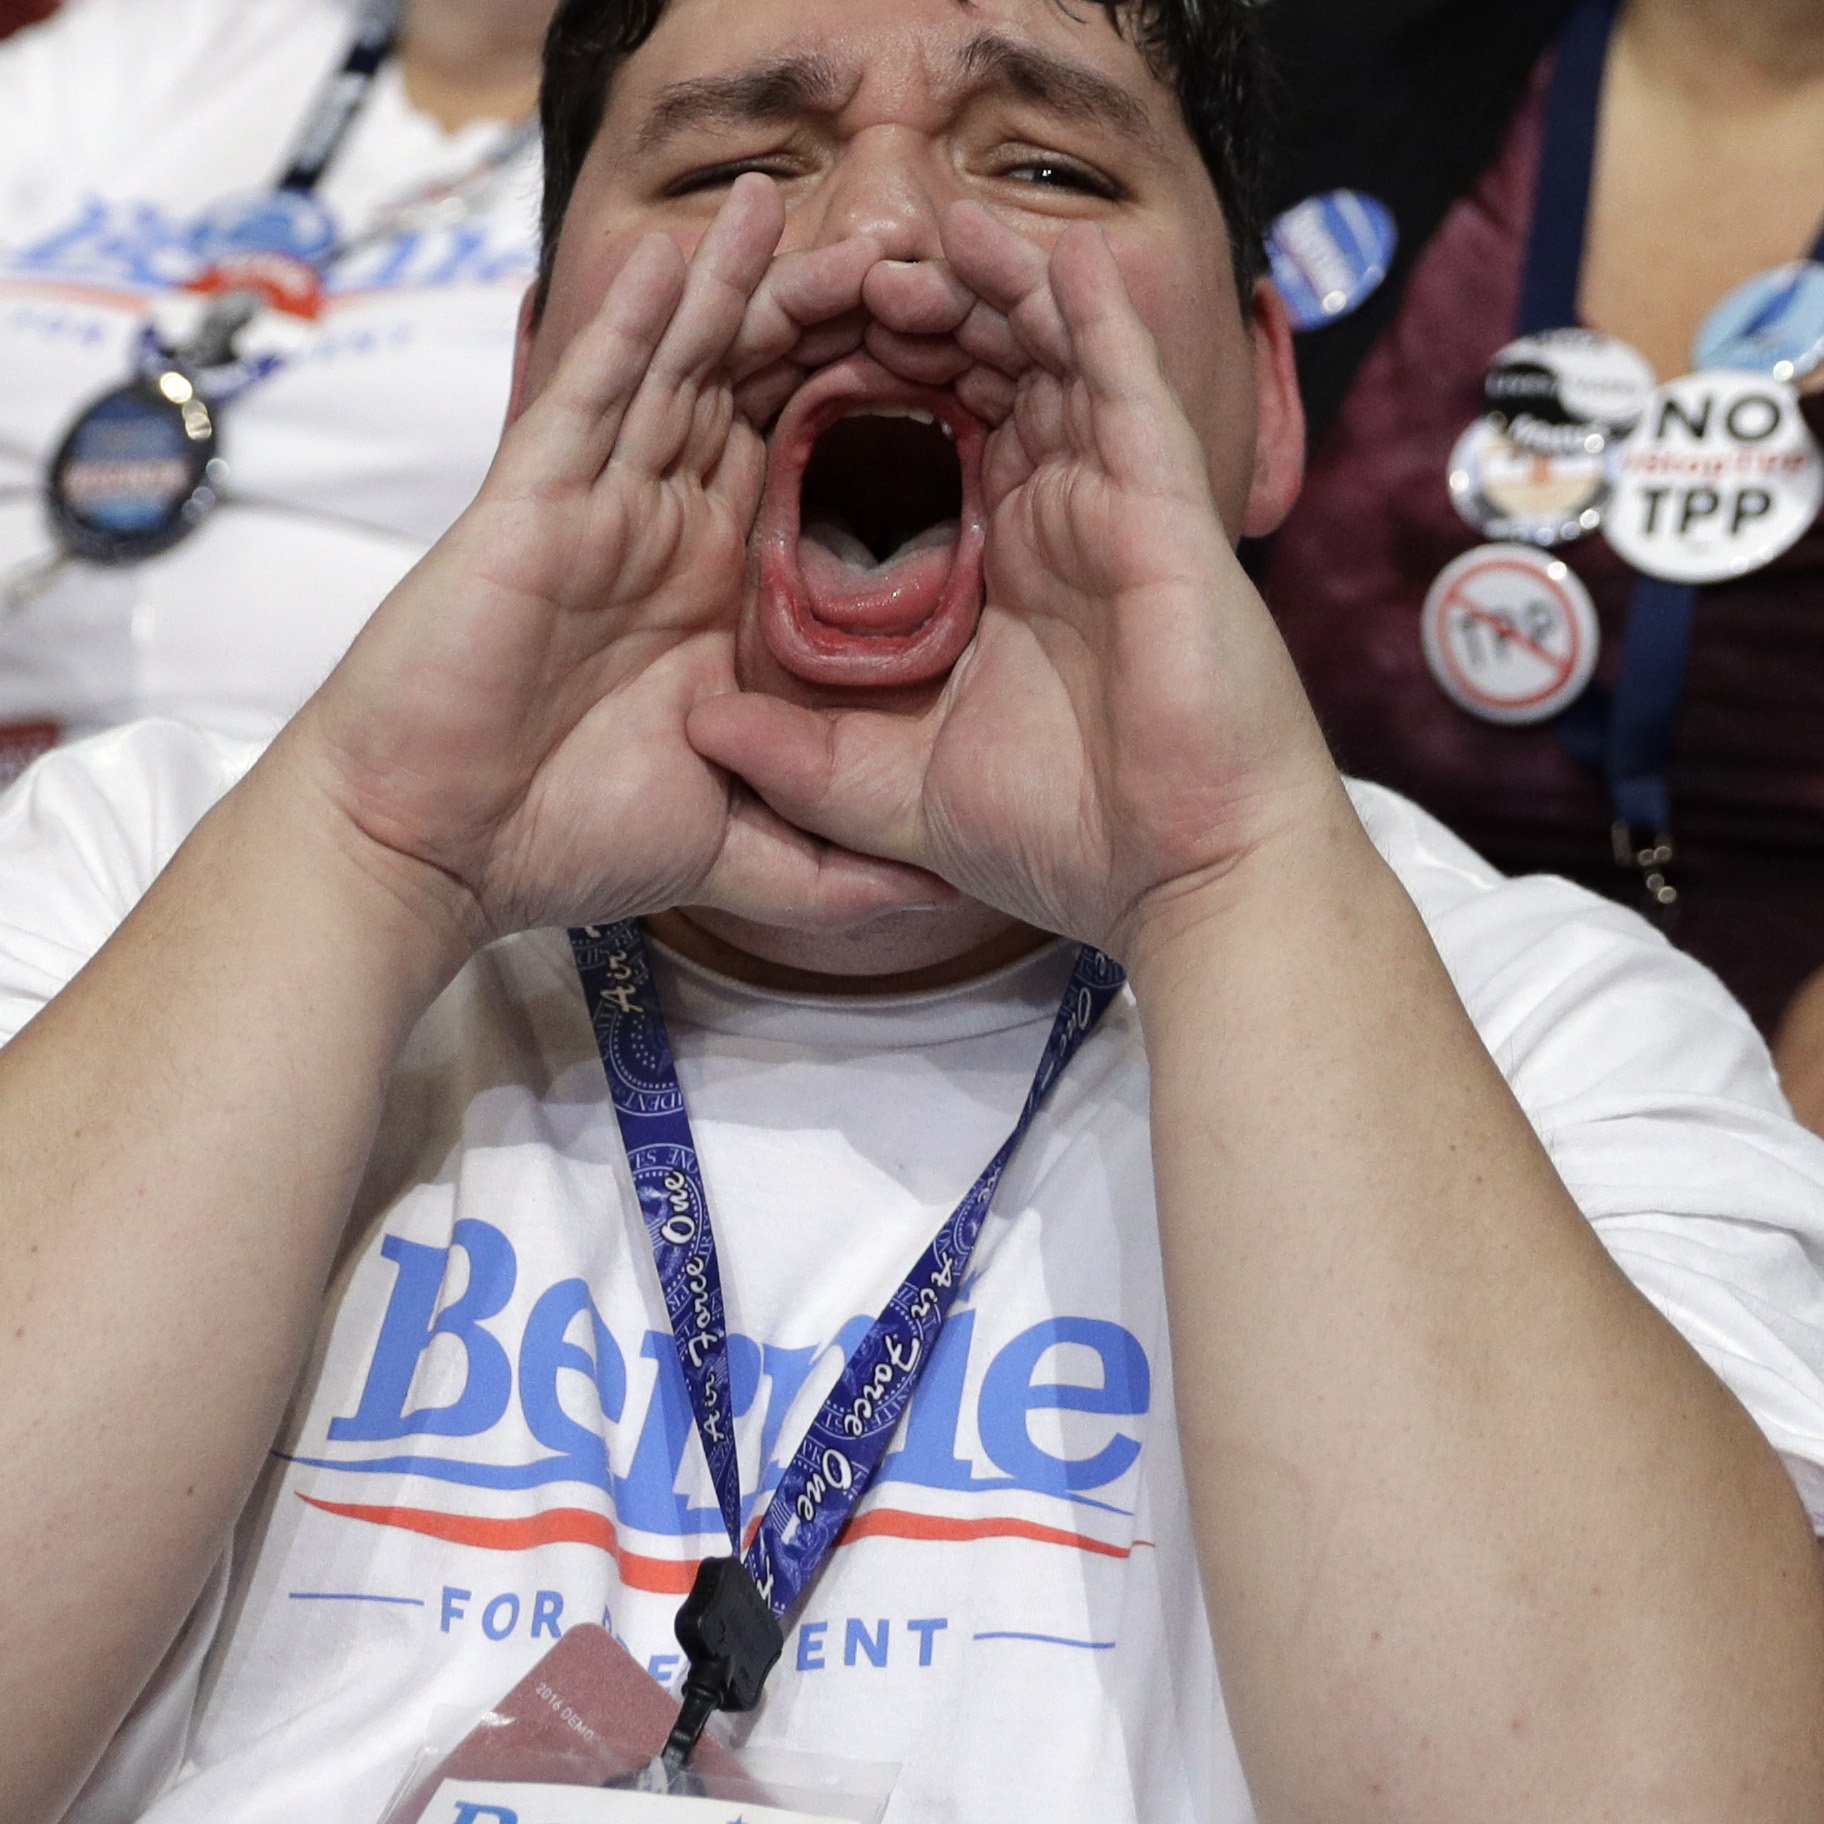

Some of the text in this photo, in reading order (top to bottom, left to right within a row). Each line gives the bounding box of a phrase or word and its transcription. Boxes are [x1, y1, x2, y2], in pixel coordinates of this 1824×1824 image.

[1657, 391, 1782, 443] NO
[1639, 486, 1772, 536] TPP
[660, 1170, 696, 1245] One
[686, 1256, 718, 1367] Force
[910, 1251, 954, 1319] Air
[843, 1334, 921, 1438] Force
[794, 1448, 854, 1522] One
[439, 1586, 565, 1641] FOR
[534, 1682, 563, 1712] 2016
